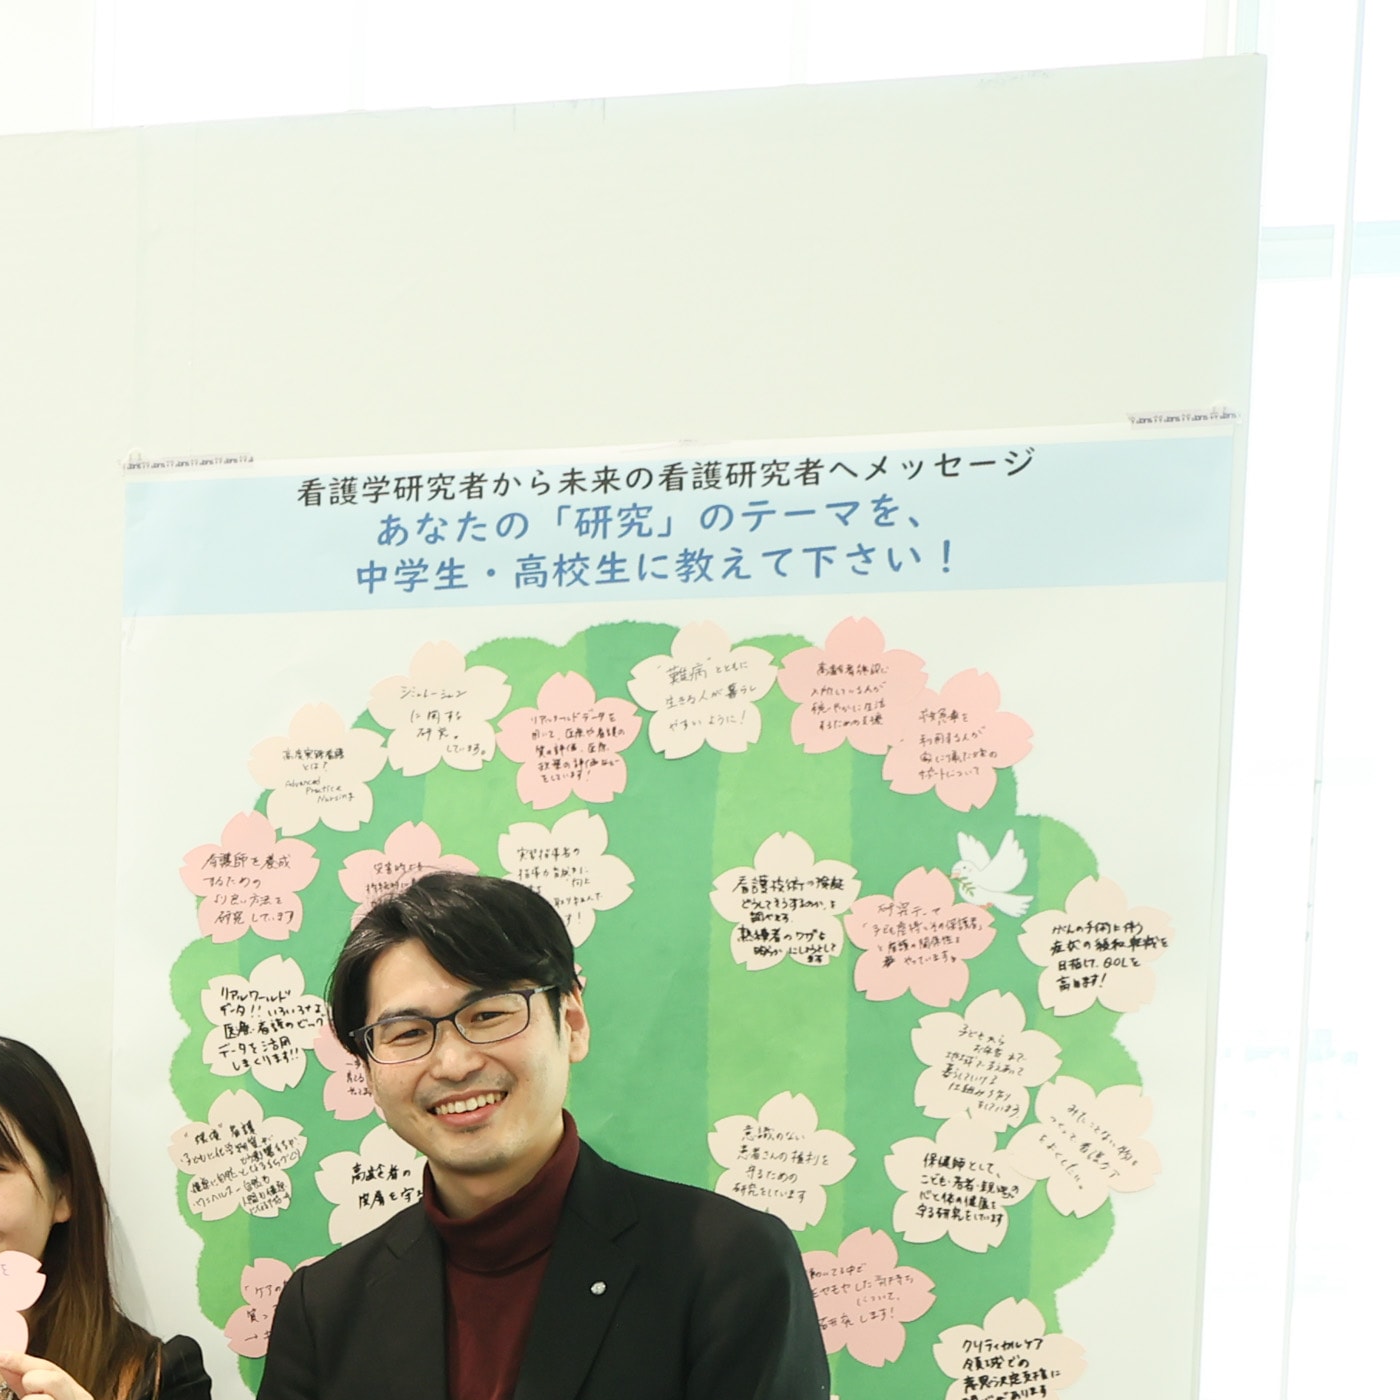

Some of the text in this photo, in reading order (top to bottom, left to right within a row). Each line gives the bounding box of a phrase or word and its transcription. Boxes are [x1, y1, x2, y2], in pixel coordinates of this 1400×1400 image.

[296, 446, 1037, 508] 看護学研究者から未来の看護研究者へメッセージ
[376, 492, 927, 549] あなたの「研究」のテーマを、
[355, 536, 956, 597] 中学生・高校生に教えて下さい!
[665, 683, 757, 709] 生きる人が暮らし
[285, 776, 321, 787] Advanced
[918, 766, 980, 780] サポートについて
[305, 785, 342, 795] Practice
[317, 792, 355, 804] Nursing
[201, 852, 291, 870] 看護師を養成
[204, 876, 262, 889] するための
[213, 892, 283, 906] より良い方法を
[214, 910, 295, 925] 研究しています
[220, 986, 291, 1003] リアルワールド
[218, 1035, 292, 1057] データを活用
[741, 1124, 806, 1141] 意識のない
[737, 1144, 830, 1167] 患者さんの権利を
[352, 1162, 411, 1184] 高齢者の
[745, 1164, 798, 1184] 守るための
[733, 1182, 807, 1204] 研究をしています
[915, 1205, 1004, 1228] 守る研究をしています
[962, 1338, 1043, 1353] クリティカルケア
